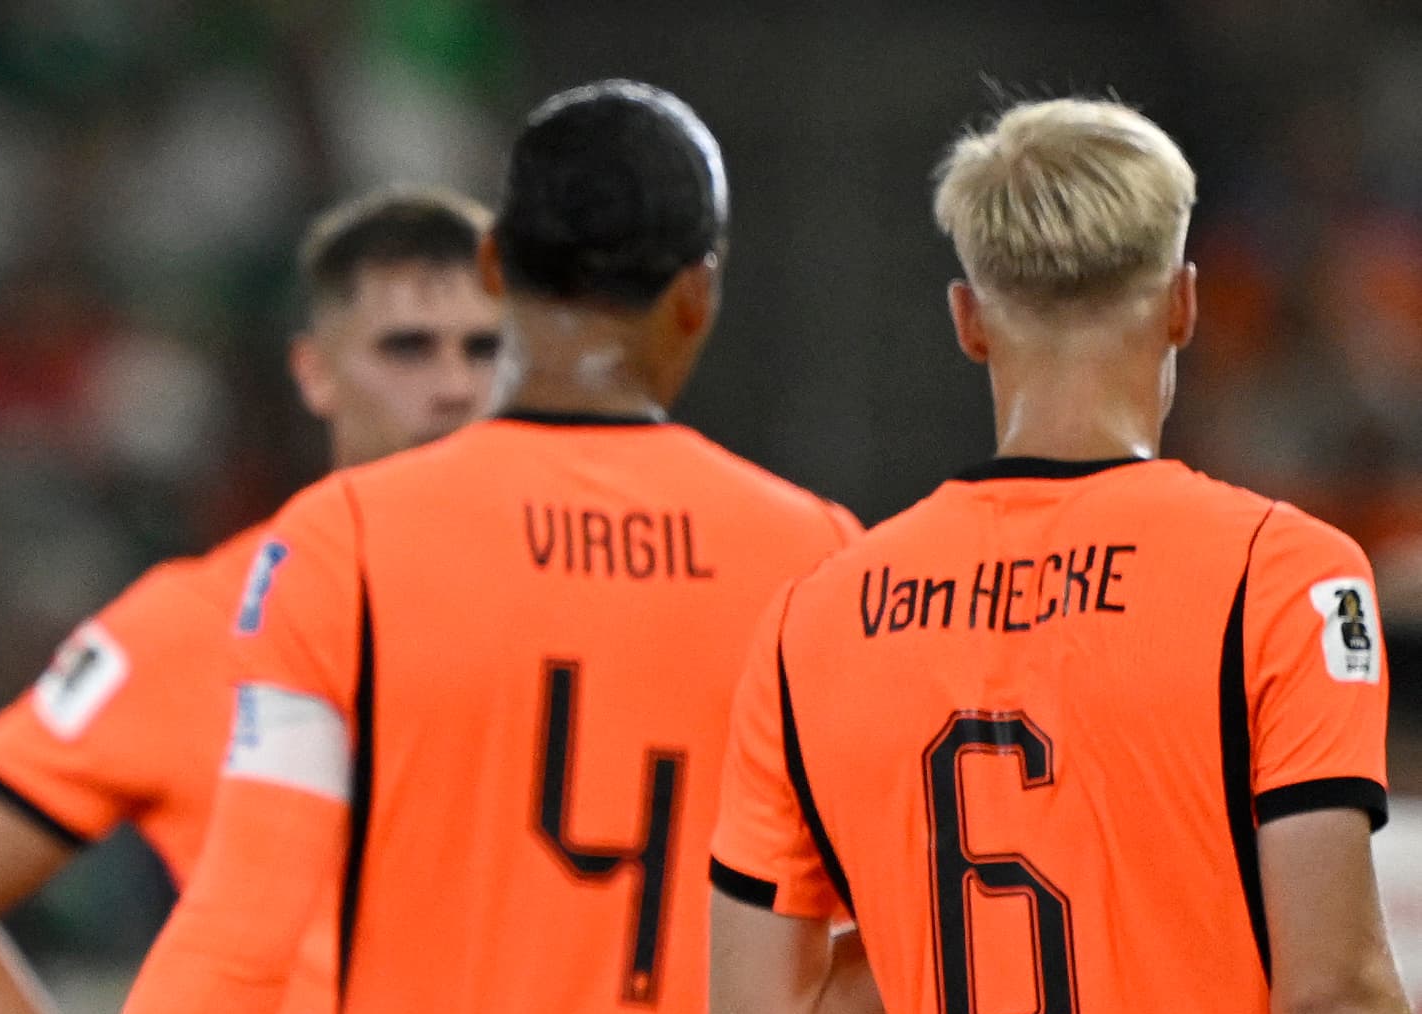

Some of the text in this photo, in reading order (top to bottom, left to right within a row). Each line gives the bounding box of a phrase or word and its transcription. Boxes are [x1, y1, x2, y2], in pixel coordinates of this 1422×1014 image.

[525, 504, 716, 580] VIRGIL
[861, 545, 1137, 638] Van HECKE
[529, 657, 688, 1009] 4
